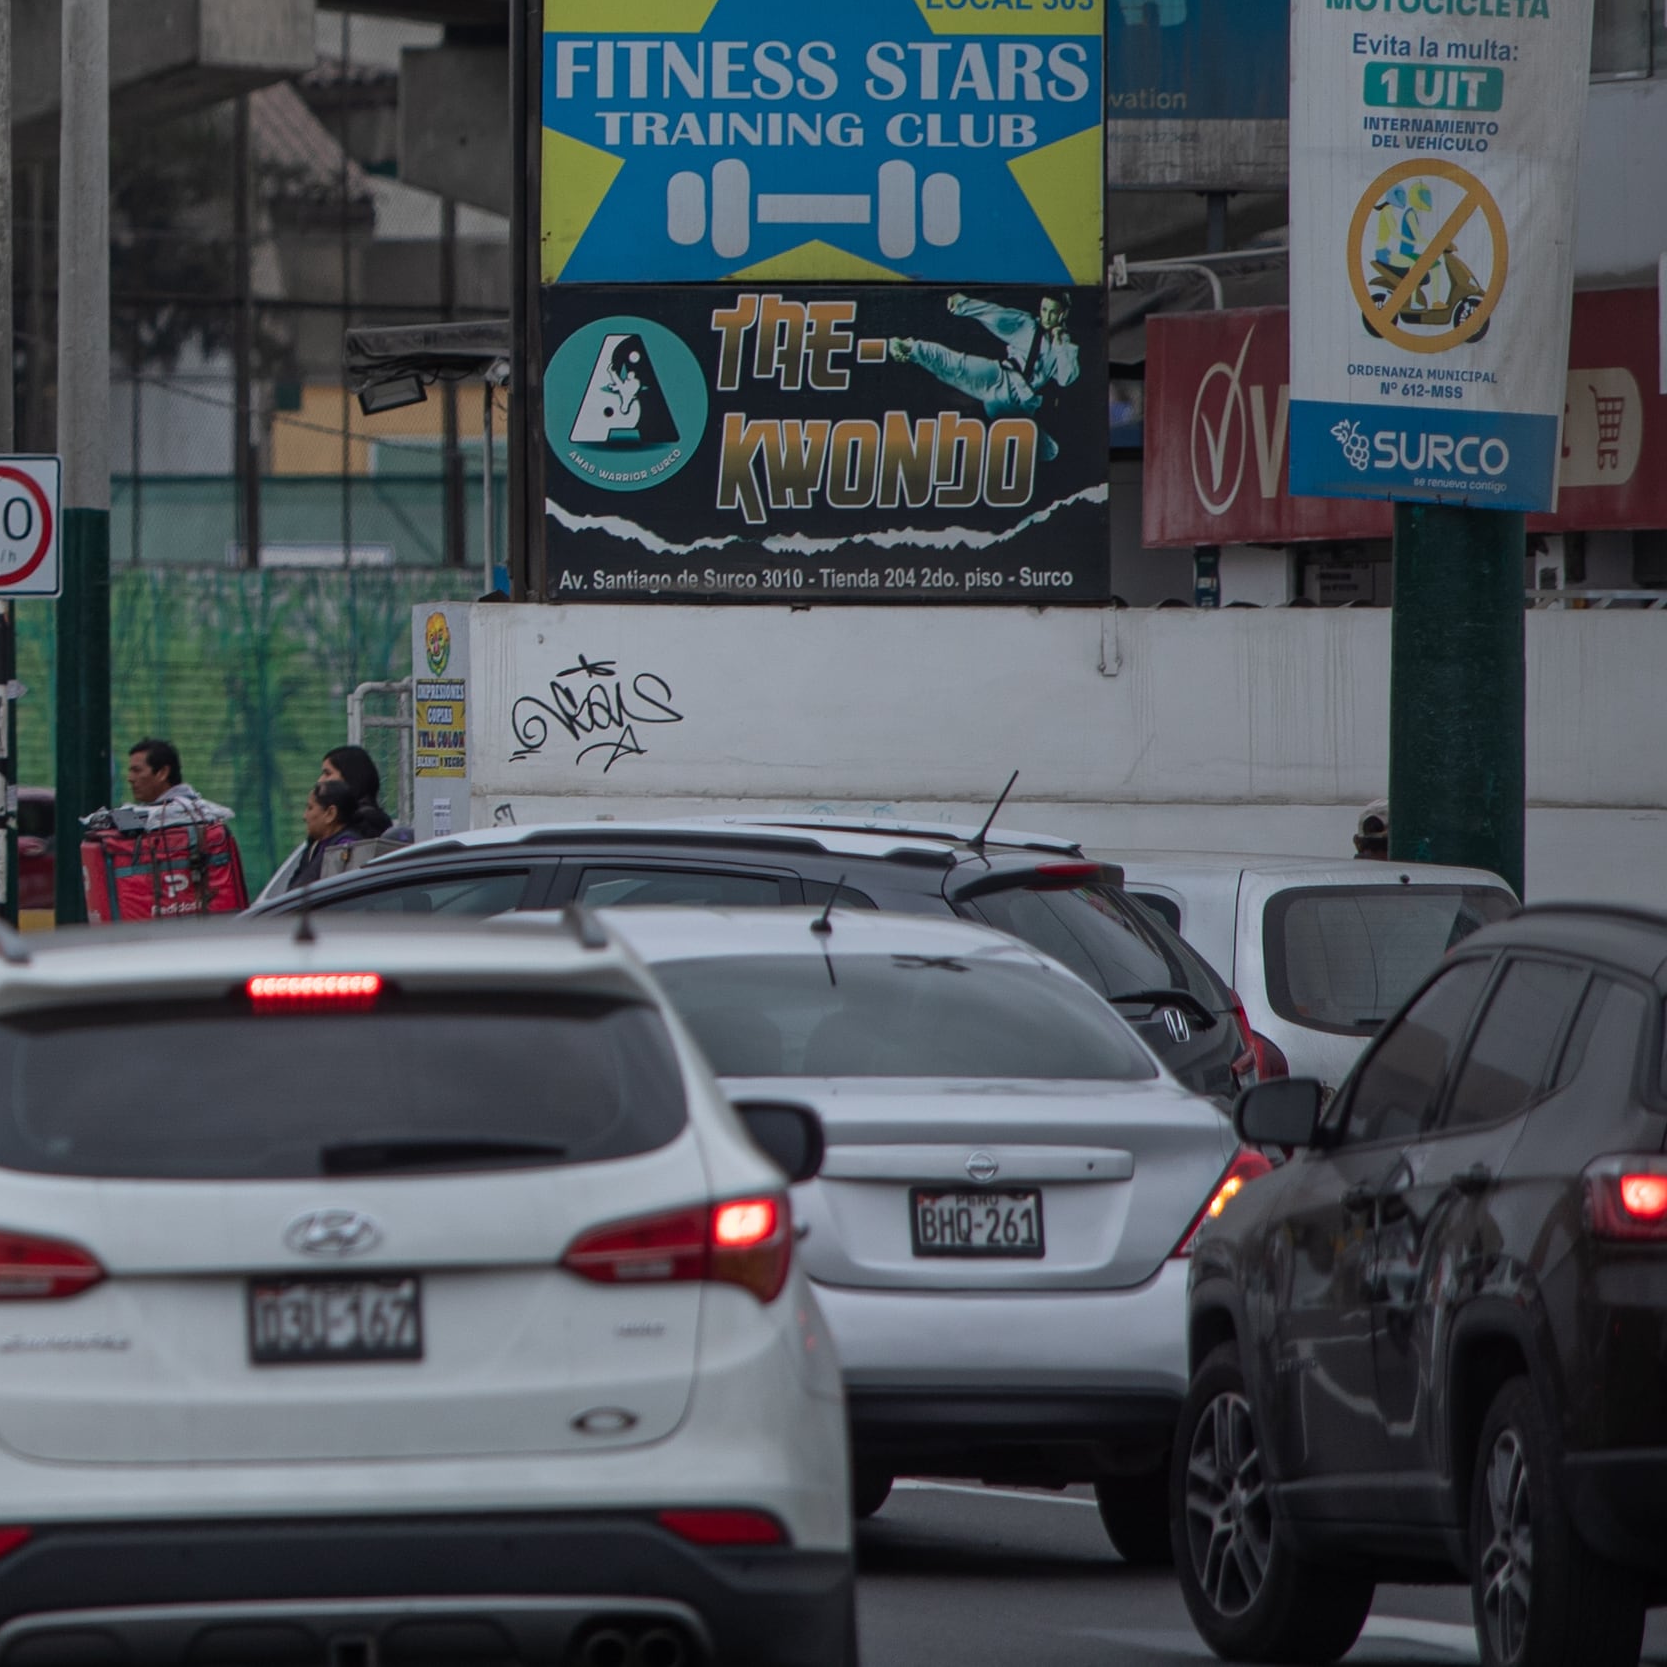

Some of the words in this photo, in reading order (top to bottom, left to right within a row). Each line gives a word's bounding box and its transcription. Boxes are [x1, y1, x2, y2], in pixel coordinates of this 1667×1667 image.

[1352, 32, 1411, 57] Evita
[1419, 36, 1439, 58] la
[1447, 38, 1519, 62] multa:
[555, 40, 838, 101] FITNESS
[865, 41, 1090, 103] STARS
[1106, 88, 1187, 110] vation
[1381, 68, 1400, 104] 1
[1414, 69, 1488, 107] UIT
[594, 111, 864, 147] TRAINING
[886, 113, 1038, 148] CLUB
[1363, 116, 1499, 136] INTERNAMIENTO
[1371, 133, 1400, 149] DEL
[1405, 134, 1489, 153] VEHÍCULO
[1347, 363, 1423, 380] ORDENANZA
[1426, 368, 1498, 384] MUNICIPAL
[1402, 383, 1463, 399] 612-MSS
[598, 468, 648, 482] WARRIOR
[650, 449, 681, 475] SURCO
[717, 411, 1038, 524] KWONDO
[1373, 430, 1510, 476] SURCO
[1413, 477, 1426, 487] se
[1427, 477, 1467, 489] renueva
[1469, 477, 1508, 493] contigo
[559, 569, 588, 590] Av.
[593, 569, 672, 594] Santiago
[676, 569, 699, 590] de
[703, 567, 757, 589] Surco
[762, 567, 804, 589] 3010
[819, 567, 880, 589] Tienda
[884, 567, 916, 588] 204
[921, 566, 959, 588] 2do.
[965, 567, 1003, 592] piso
[1019, 566, 1074, 587] Surco
[417, 683, 465, 700] IMPRESIONES
[920, 1207, 1036, 1245] BHQ-261
